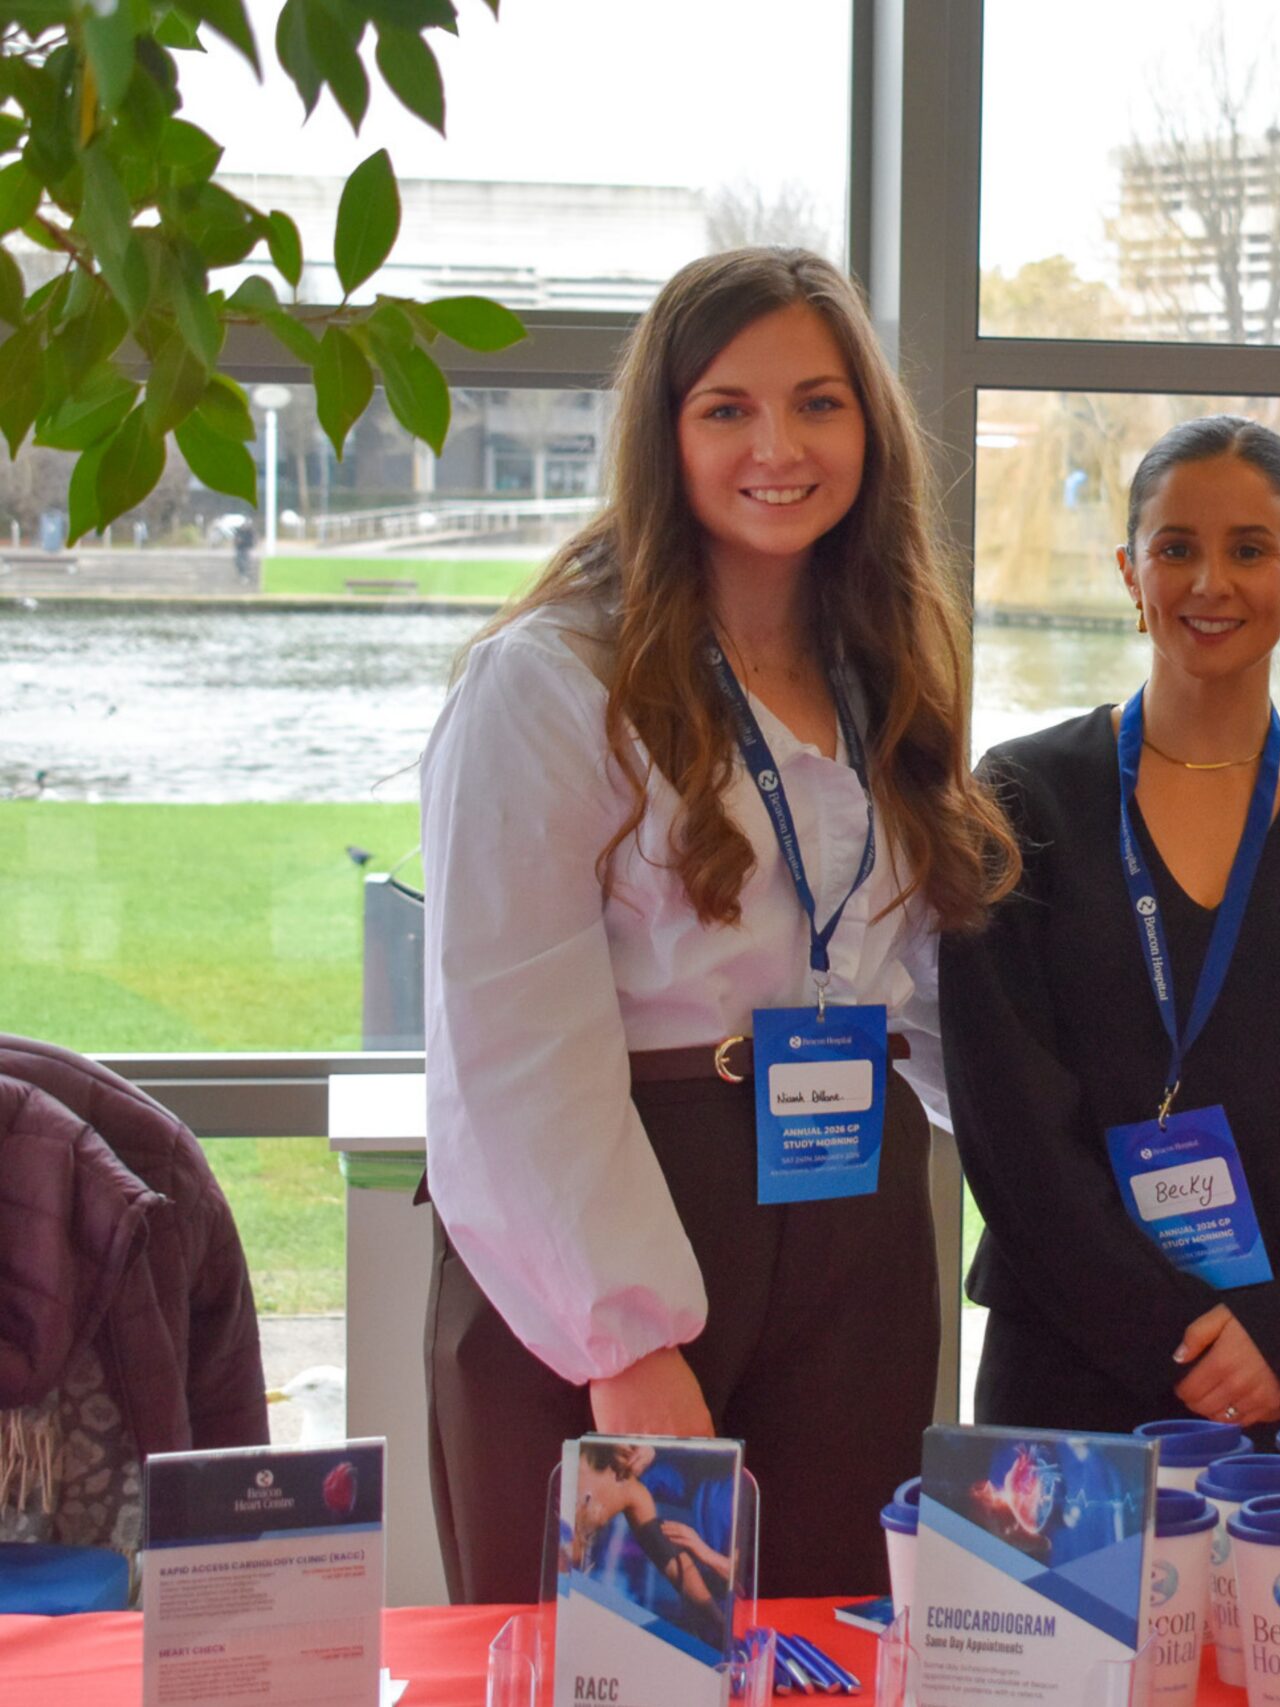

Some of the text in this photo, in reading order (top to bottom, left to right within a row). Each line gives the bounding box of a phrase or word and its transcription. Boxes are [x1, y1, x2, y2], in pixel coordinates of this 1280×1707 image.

[768, 792, 802, 881] Beacon Hospital
[1144, 916, 1168, 1001] Beacon Hospital
[783, 1123, 860, 1137] ANNUAL 2026 GP
[783, 1135, 860, 1150] STUDY MORNING
[1159, 1225, 1195, 1238] ANNUAL
[1161, 1228, 1235, 1250] STUDY MORNING
[160, 1566, 189, 1577] RAPID
[191, 1563, 230, 1574] ACCESS
[231, 1557, 295, 1570] CARDIOLOGY
[296, 1553, 328, 1565] CLINIC
[926, 1606, 1057, 1637] ECHOCARDIOGRAM
[925, 1634, 1024, 1655] Same Day Appointments
[574, 1676, 620, 1702] RACC
